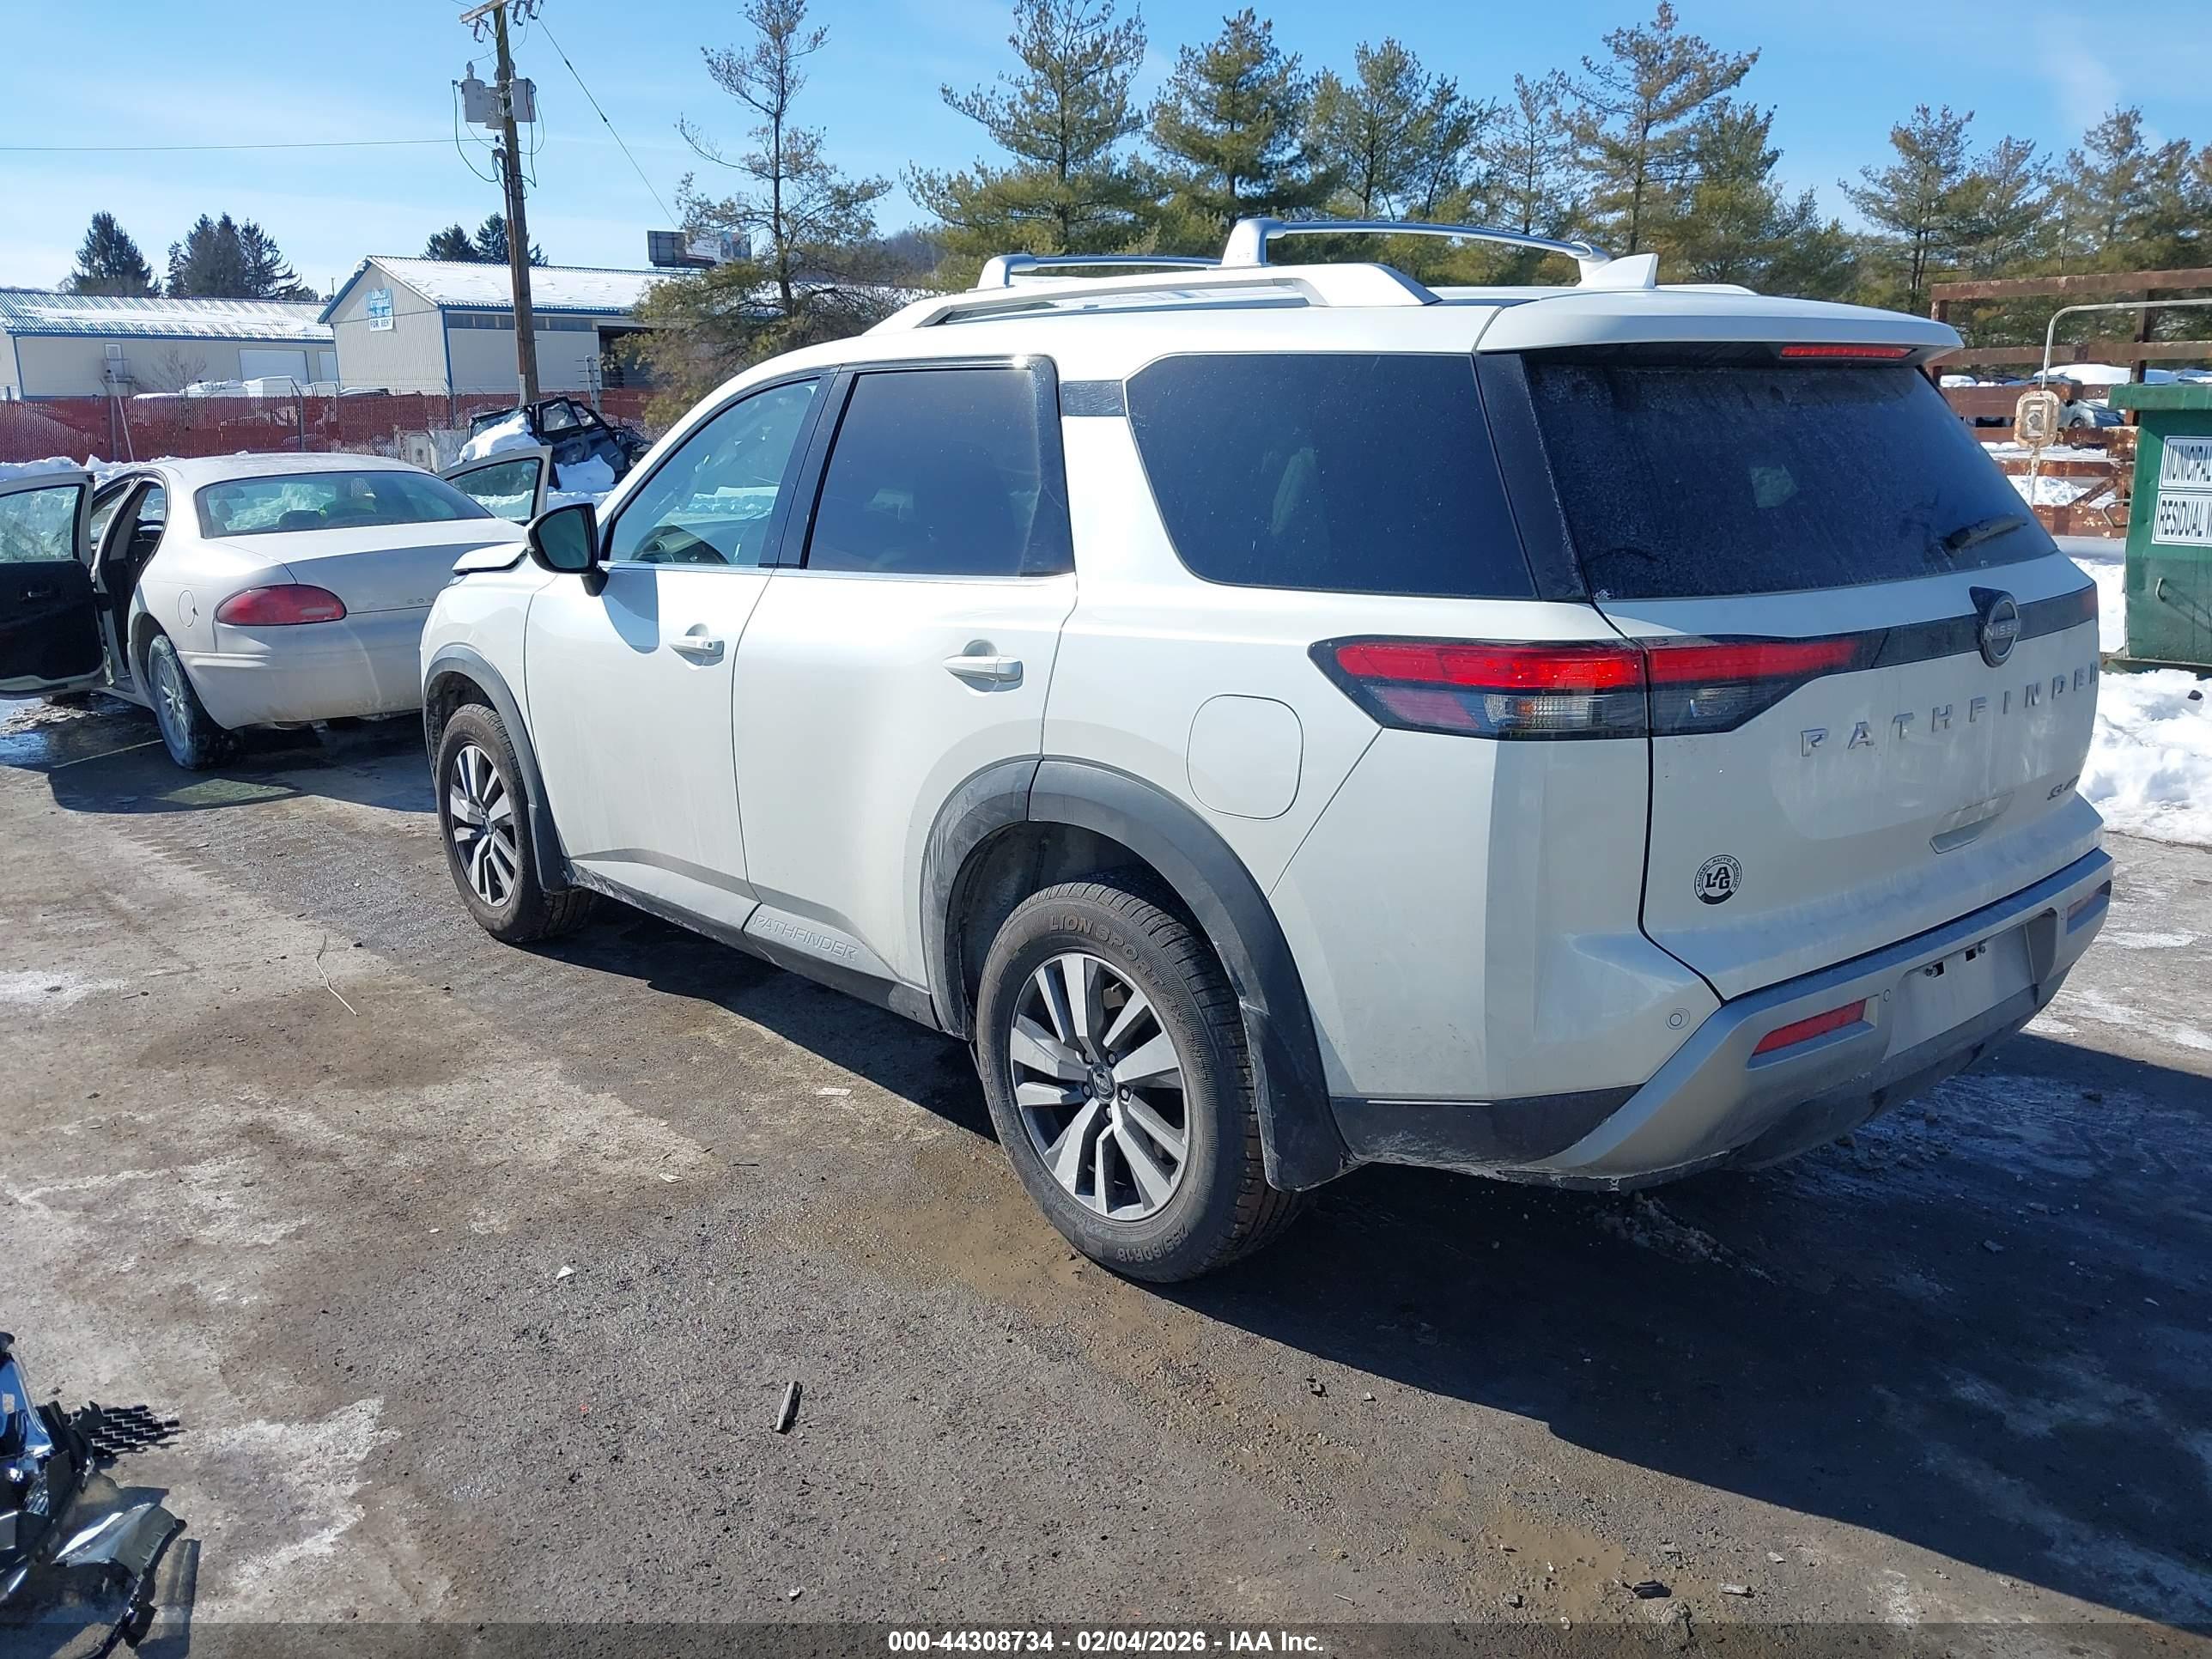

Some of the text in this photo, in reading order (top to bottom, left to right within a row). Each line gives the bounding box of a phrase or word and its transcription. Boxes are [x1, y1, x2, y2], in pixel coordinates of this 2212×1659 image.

[370, 319, 392, 329] FOR RENT
[2164, 444, 2211, 483] MUNICIPAL
[2157, 500, 2203, 537] RESIDUAL
[752, 914, 859, 961] PATHFINDER
[1049, 915, 1094, 934] LION
[1095, 924, 1164, 988] SPORT
